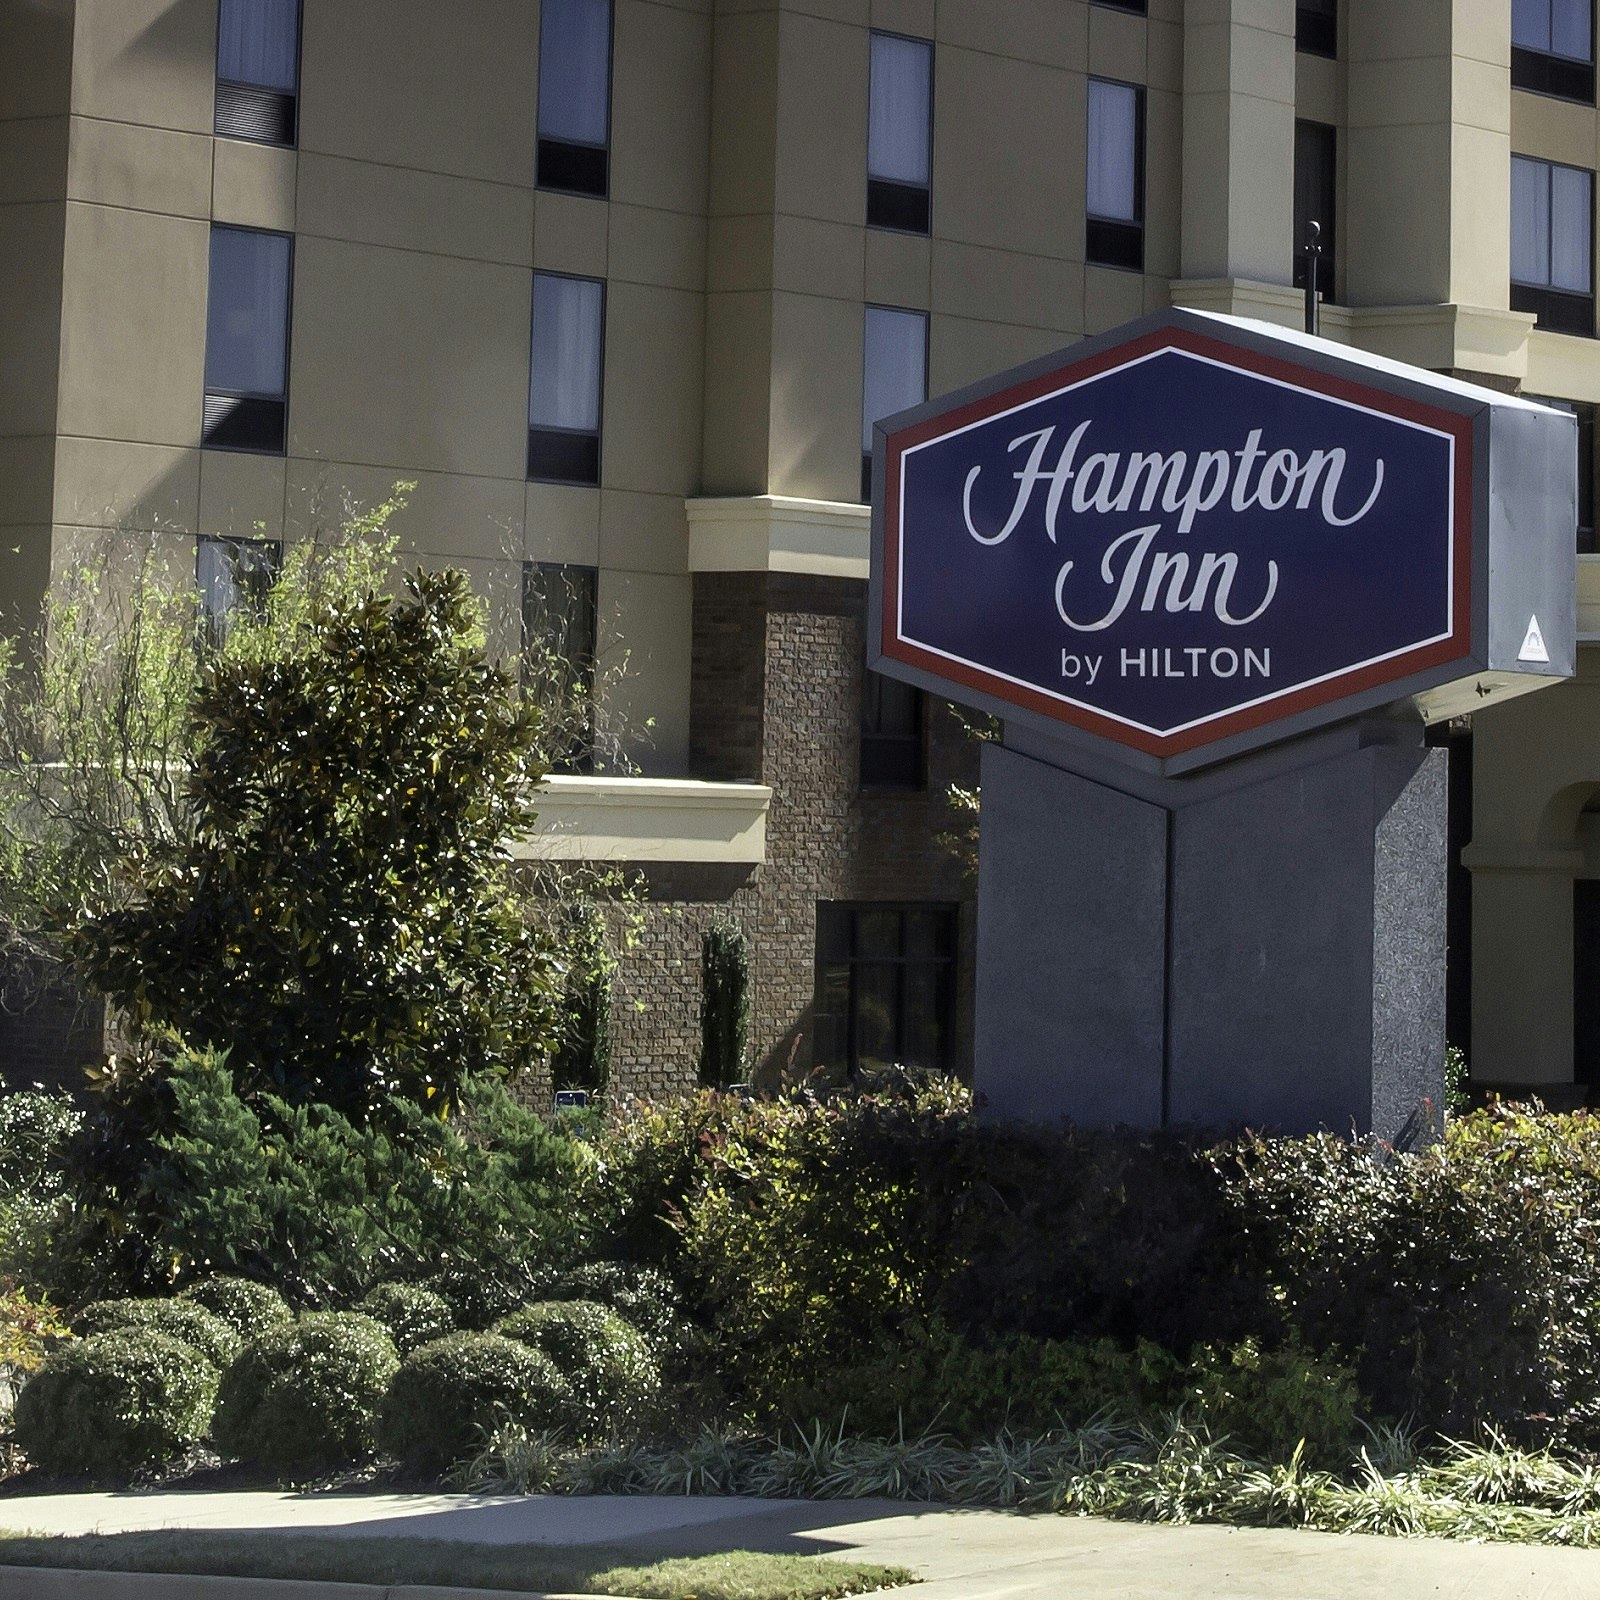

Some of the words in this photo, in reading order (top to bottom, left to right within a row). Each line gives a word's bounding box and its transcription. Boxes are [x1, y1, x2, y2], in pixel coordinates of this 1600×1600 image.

[963, 419, 1384, 546] Hampton
[1054, 523, 1279, 632] Inn
[1060, 647, 1103, 686] by
[1119, 646, 1271, 679] HILTON
